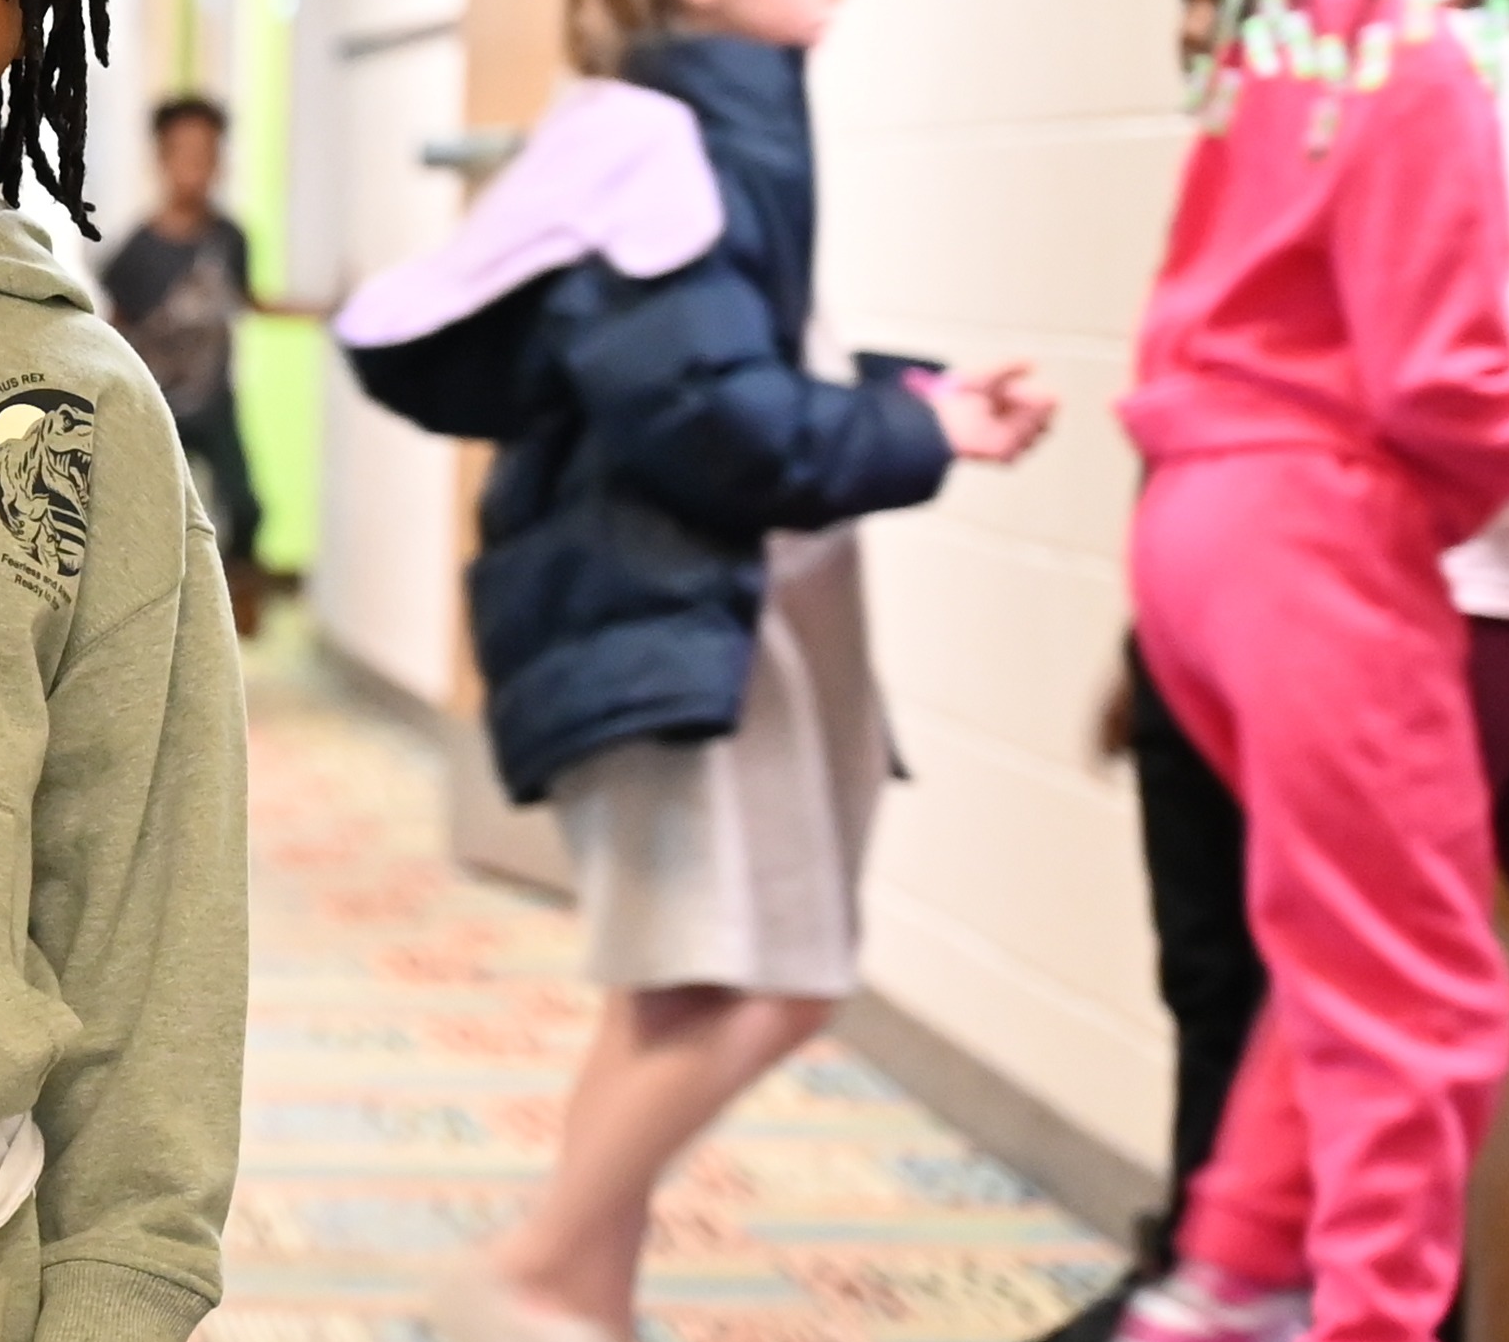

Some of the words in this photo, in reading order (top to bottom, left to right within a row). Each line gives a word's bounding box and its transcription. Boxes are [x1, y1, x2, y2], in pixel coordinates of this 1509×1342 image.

[21, 372, 46, 385] REX
[1, 553, 42, 581] Fearless
[14, 573, 43, 598] Ready
